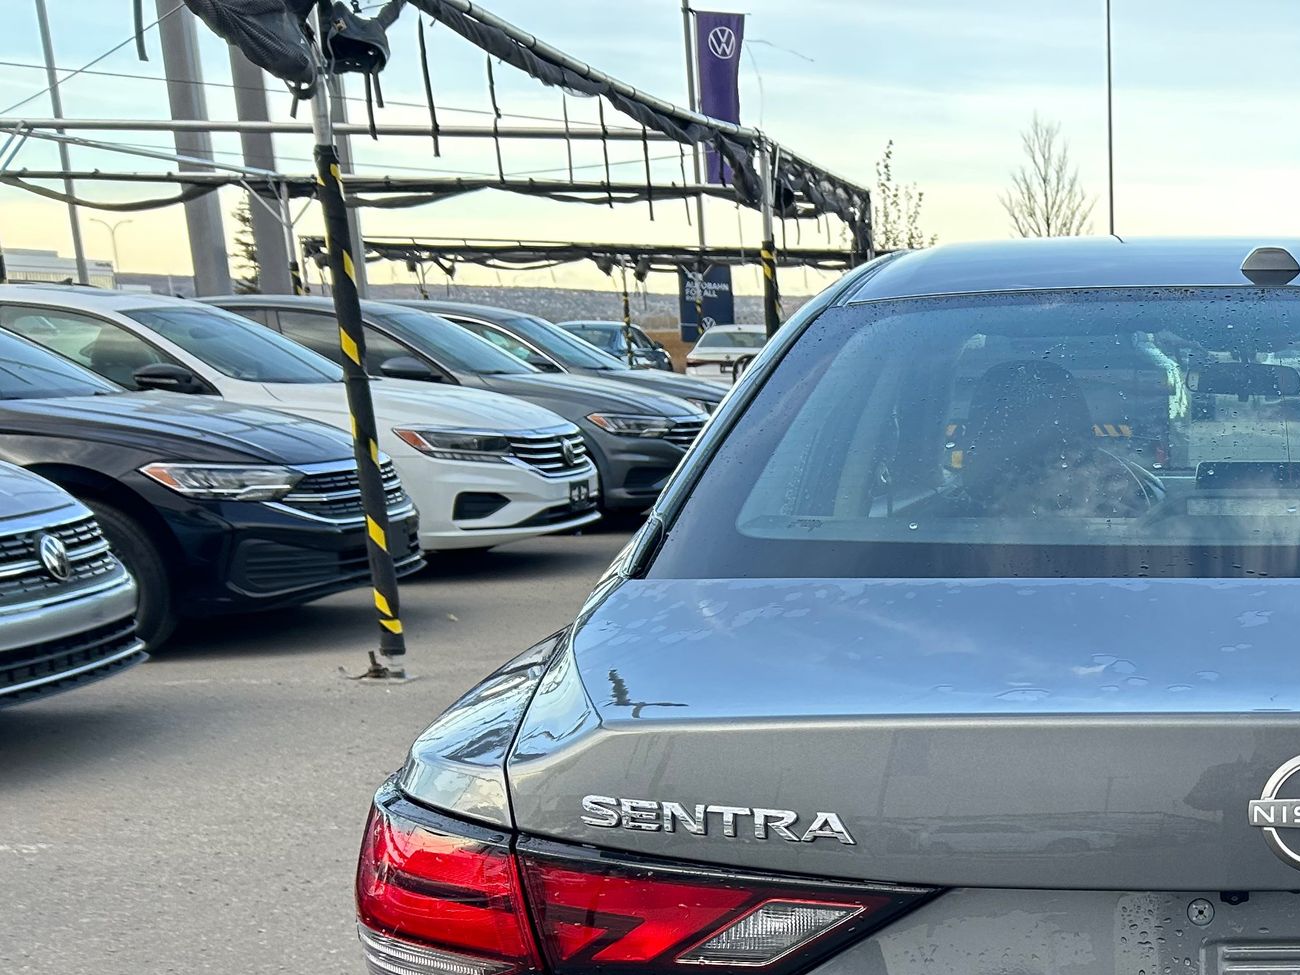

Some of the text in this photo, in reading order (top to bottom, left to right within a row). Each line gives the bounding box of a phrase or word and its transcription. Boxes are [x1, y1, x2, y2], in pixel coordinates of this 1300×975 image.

[708, 26, 736, 59] VW
[685, 281, 729, 292] AUOBAHN
[703, 289, 718, 298] ALL
[580, 794, 857, 845] SENTRA
